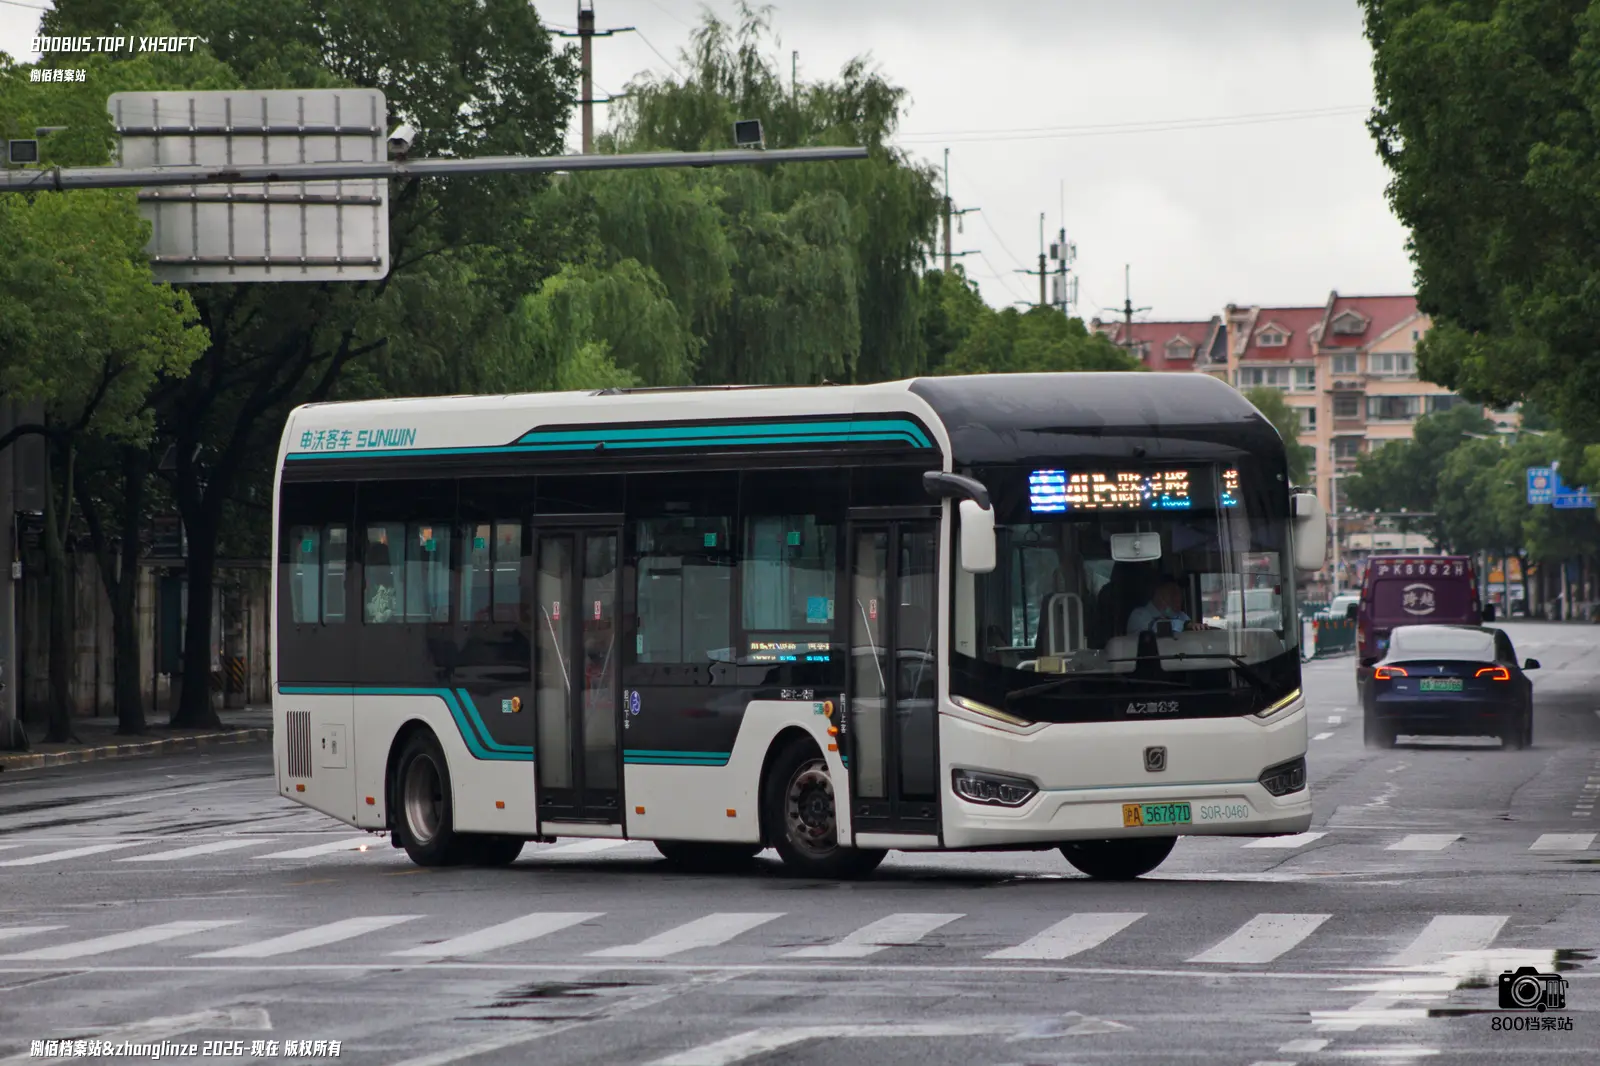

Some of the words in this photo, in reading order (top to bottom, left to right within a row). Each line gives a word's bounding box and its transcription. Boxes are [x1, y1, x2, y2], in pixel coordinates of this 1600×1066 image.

[300, 429, 352, 450] 申沃客车
[356, 428, 416, 448] SUNWIN
